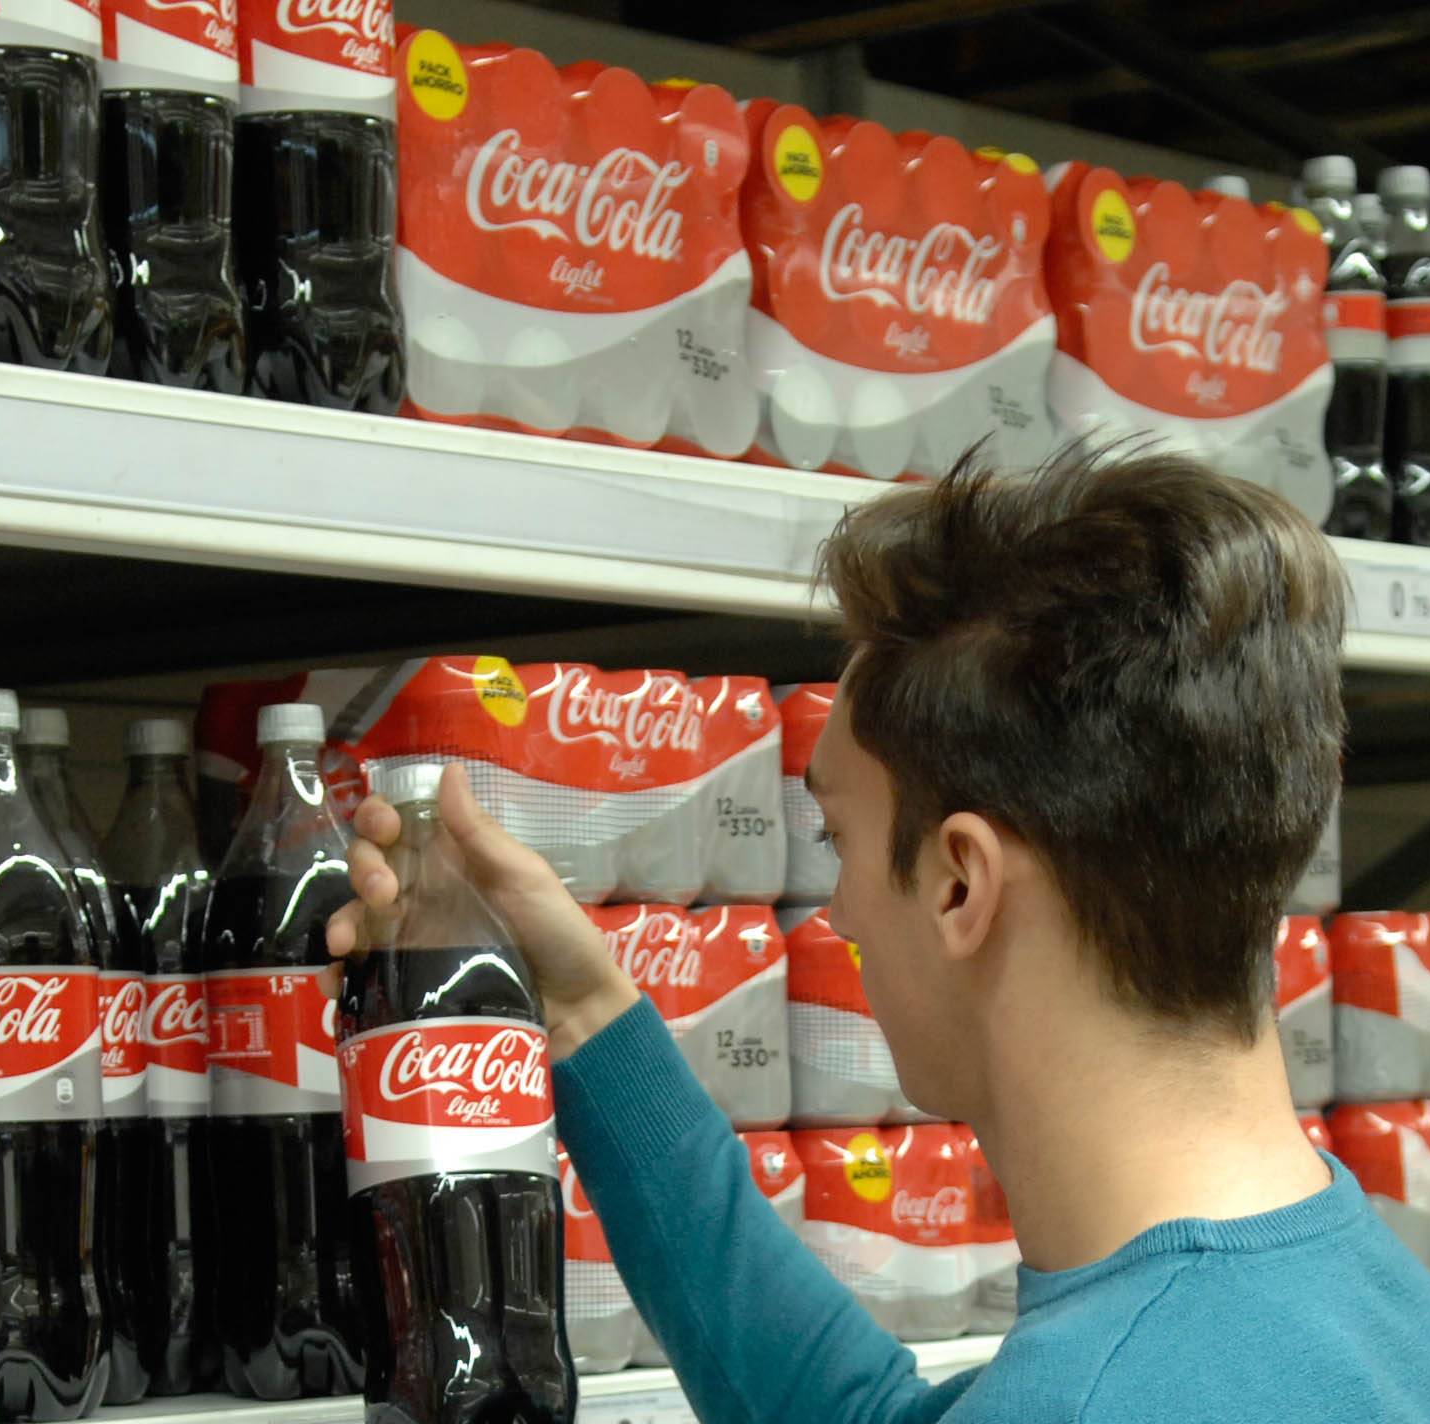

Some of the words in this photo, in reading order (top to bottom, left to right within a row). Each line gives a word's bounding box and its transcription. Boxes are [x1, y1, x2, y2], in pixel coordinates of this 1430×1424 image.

[341, 37, 382, 66] light
[418, 58, 452, 78] PACK
[412, 73, 465, 97] AHORRO
[466, 128, 694, 262] Coca-Cola
[549, 255, 606, 296] light
[820, 202, 1001, 324] Coca-Cola
[1131, 262, 1289, 373] Coca-Cola
[884, 322, 932, 358] light
[1185, 370, 1228, 404] light
[547, 667, 703, 753] Coca-Cola
[609, 753, 648, 782] light
[716, 797, 734, 816] 12
[729, 816, 766, 838] 330
[268, 975, 294, 996] 1,5
[716, 1029, 734, 1048] 12
[380, 1028, 547, 1102] Coca-Cola
[729, 1046, 769, 1068] 330
[445, 1093, 501, 1123] light
[891, 1184, 968, 1229] Coca-Cola
